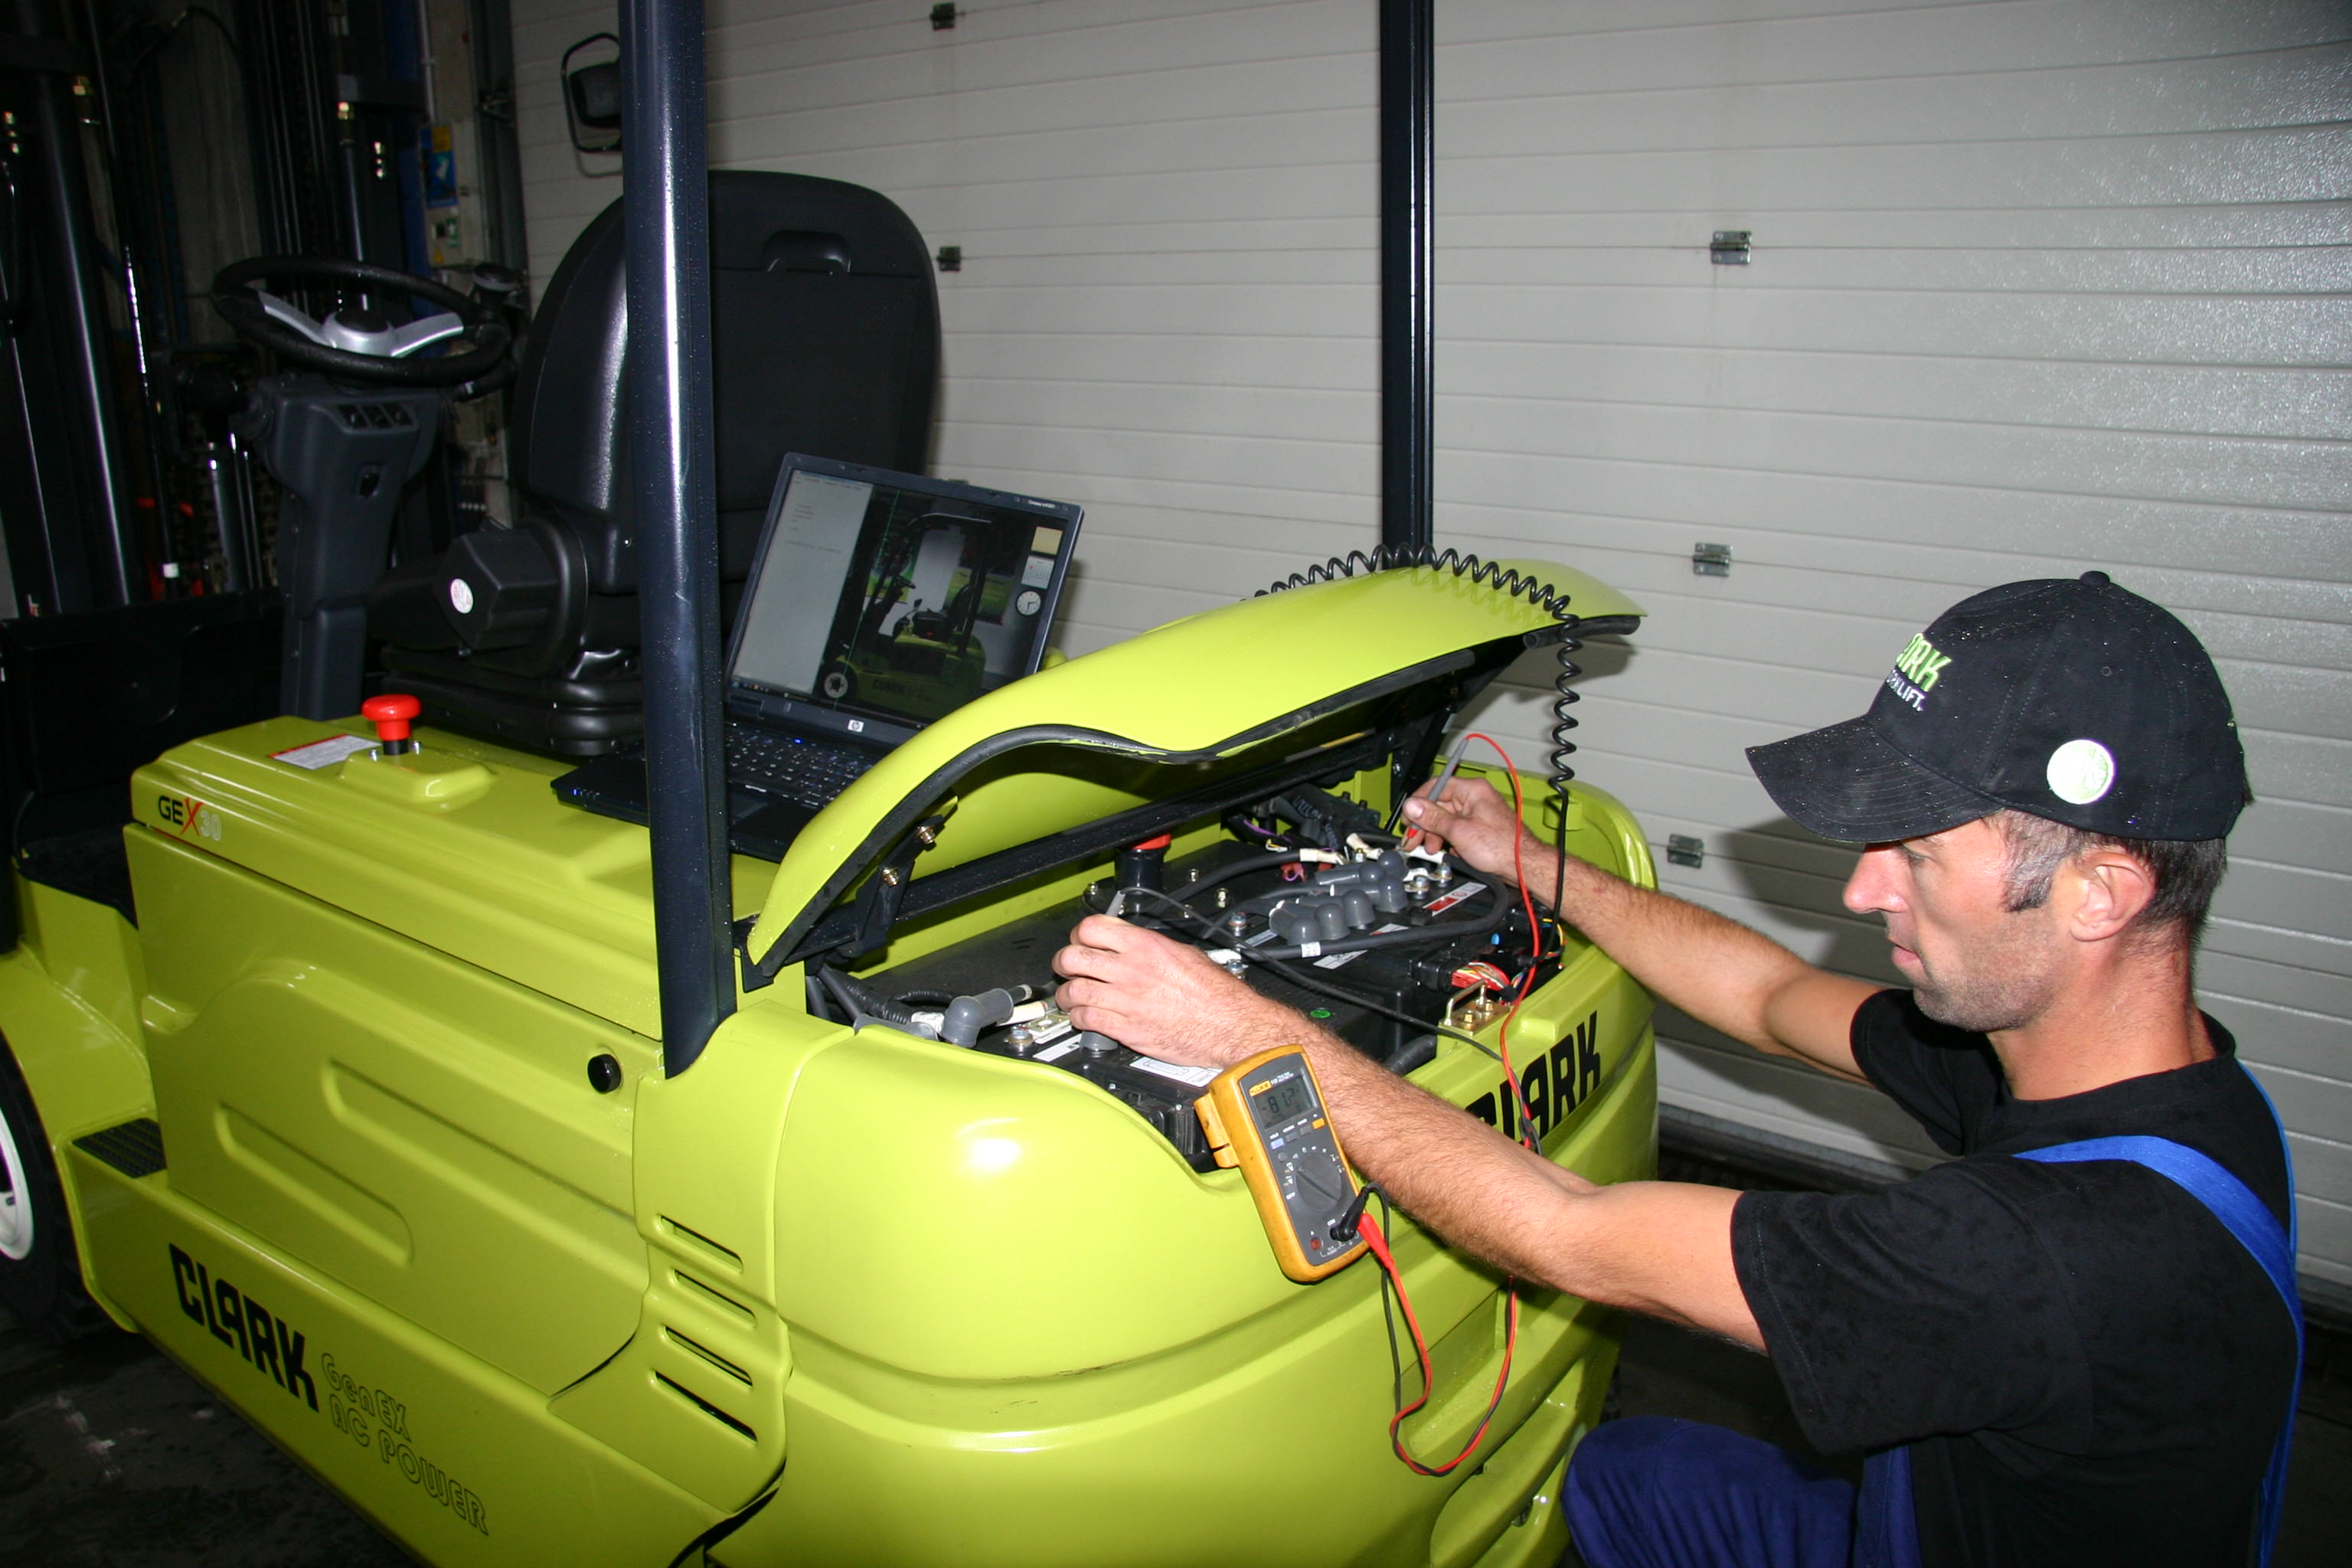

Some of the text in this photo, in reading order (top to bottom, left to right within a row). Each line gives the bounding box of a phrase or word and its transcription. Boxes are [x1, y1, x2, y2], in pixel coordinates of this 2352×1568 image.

[1896, 632, 1952, 692] ARK
[168, 1243, 320, 1413] CLARK
[322, 1352, 412, 1443] GenEX
[329, 1395, 490, 1537] AC POWER
